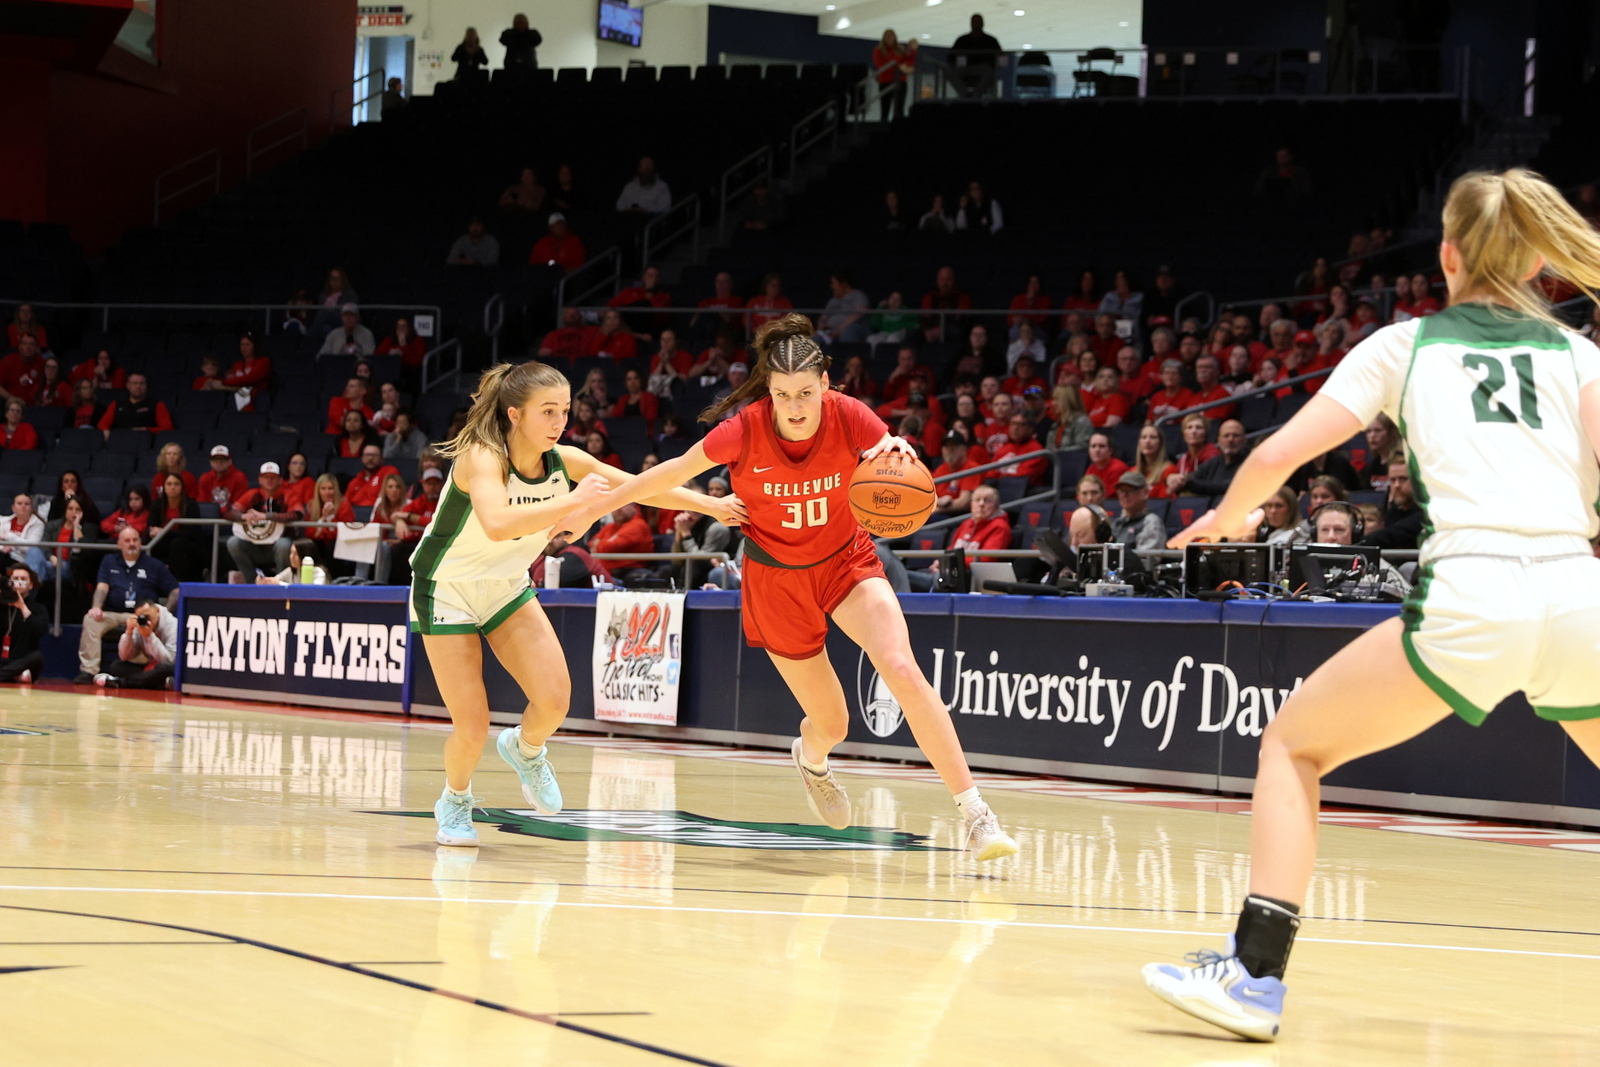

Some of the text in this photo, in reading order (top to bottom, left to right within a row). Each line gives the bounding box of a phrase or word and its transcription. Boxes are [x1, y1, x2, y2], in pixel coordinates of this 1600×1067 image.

[368, 14, 404, 26] DECK
[1462, 353, 1543, 430] 21
[763, 472, 842, 497] BELLEVUE
[779, 496, 829, 529] 30
[185, 614, 407, 684] DAYTON FLYERS
[638, 684, 659, 703] HITS
[932, 647, 1132, 748] University
[1141, 655, 1194, 752] of
